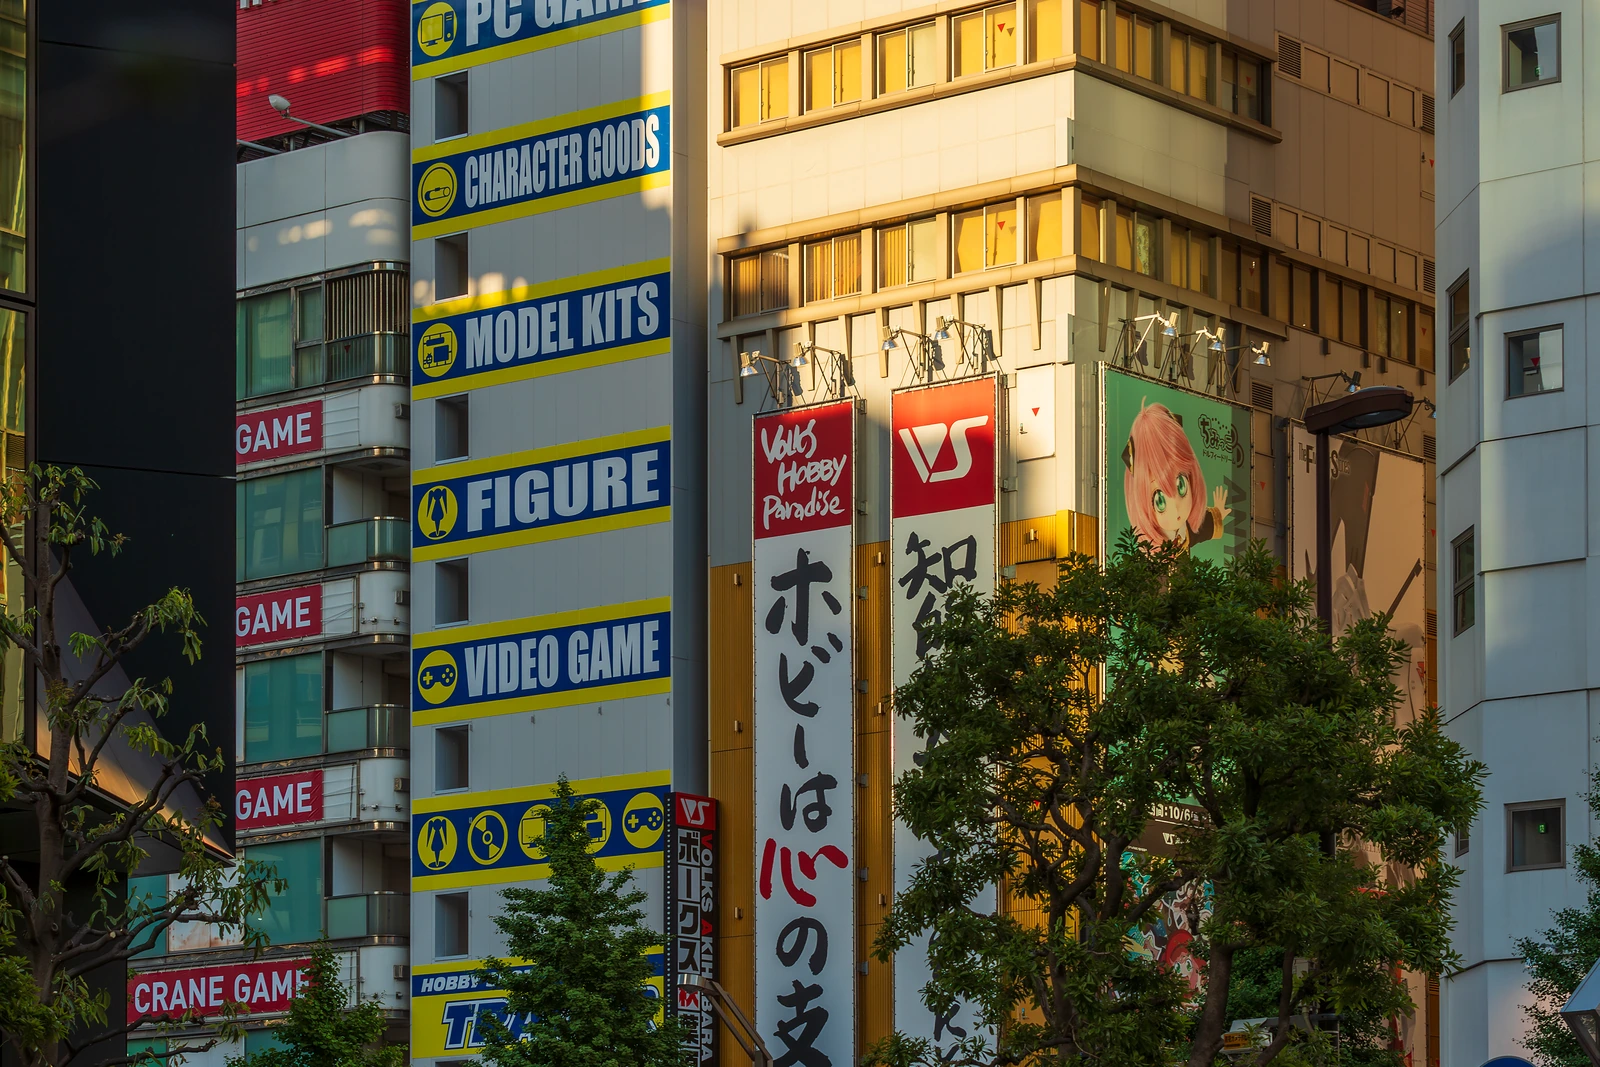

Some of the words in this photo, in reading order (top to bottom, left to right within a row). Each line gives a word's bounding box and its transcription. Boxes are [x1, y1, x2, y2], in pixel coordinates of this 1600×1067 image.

[466, 0, 522, 46] PC
[464, 133, 582, 208] CHARACTER
[587, 114, 660, 181] GOODS
[466, 299, 574, 369] MODEL
[582, 281, 659, 347] KITS
[236, 411, 312, 455] GAME
[467, 449, 659, 533] FIGURE
[236, 595, 311, 637] GAME
[464, 634, 560, 698] VIDEO
[567, 619, 660, 684] GAME
[236, 780, 312, 821] GAME
[700, 833, 714, 913] VOLKS
[134, 975, 224, 1014] CRANE
[421, 974, 480, 993] HOBBY
[700, 918, 714, 1062] AKIHBARA
